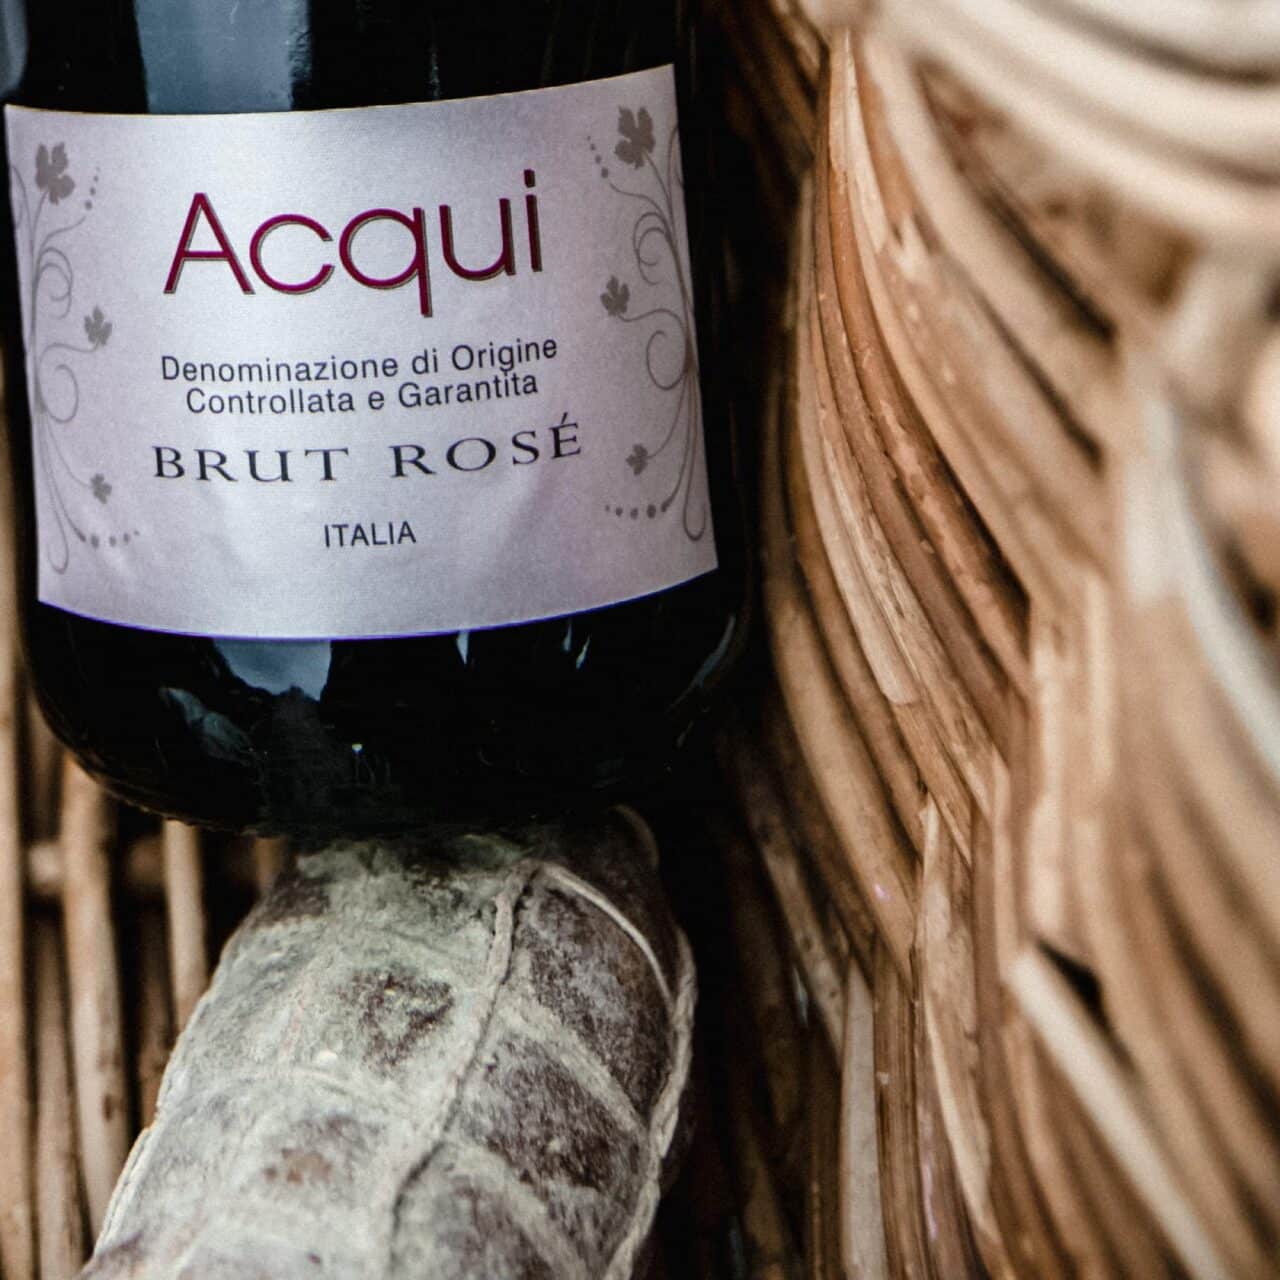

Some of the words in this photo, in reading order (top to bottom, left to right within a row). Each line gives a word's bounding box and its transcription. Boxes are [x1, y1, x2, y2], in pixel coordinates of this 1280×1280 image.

[164, 168, 543, 318] Acqui
[161, 354, 399, 383] Denominazione
[411, 348, 439, 376] di
[451, 336, 558, 375] Origine
[185, 385, 355, 415] Controllata
[368, 390, 385, 411] e
[397, 372, 539, 408] Garantita
[152, 445, 350, 484] BRUT
[390, 411, 583, 479] ROSÉ
[323, 520, 417, 548] ITALIA
